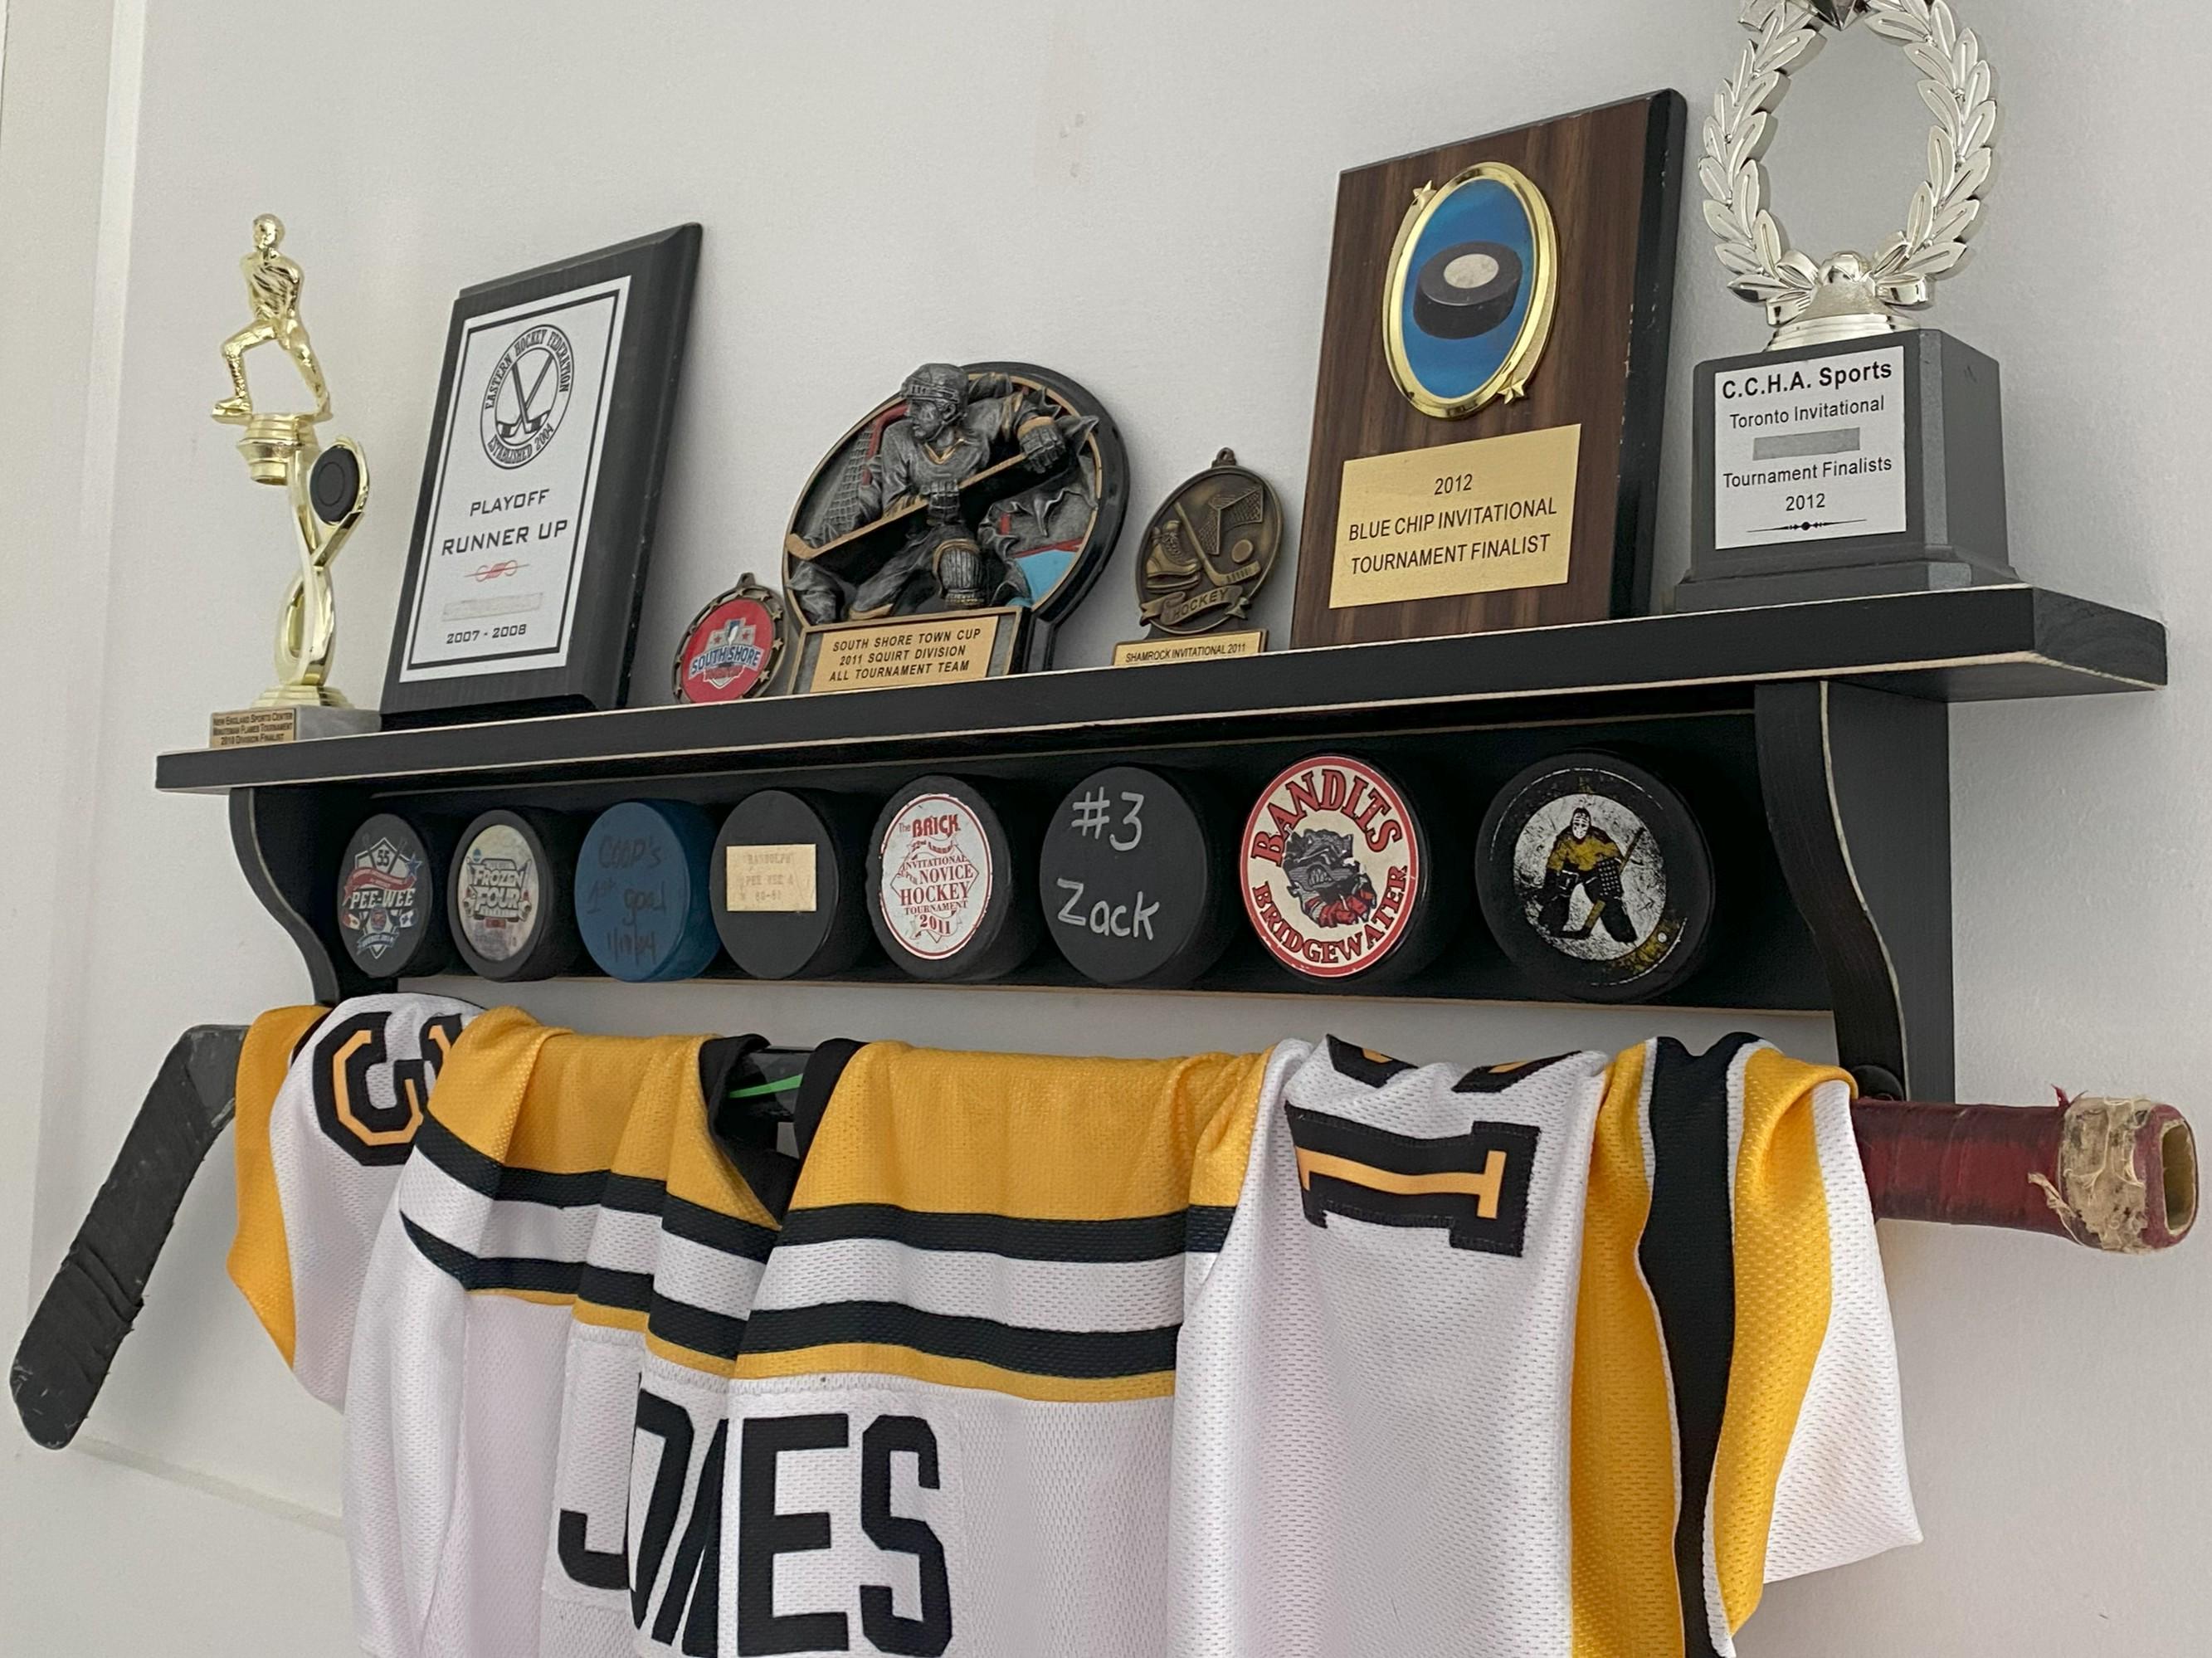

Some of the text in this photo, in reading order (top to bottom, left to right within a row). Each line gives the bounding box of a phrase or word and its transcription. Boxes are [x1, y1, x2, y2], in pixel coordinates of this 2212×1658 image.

[485, 329, 572, 410] EASTERN HOCKEY FEDERATION
[1722, 361, 1893, 399] C.C.H.A. Sports
[1730, 395, 1884, 429] Toronto Invitational
[487, 423, 553, 464] ESTABLISHED 2004
[1434, 474, 1473, 495] 2012
[1723, 457, 1893, 488] Tournament Finalists
[470, 489, 550, 516] PLAYOFF
[1786, 493, 1826, 512] 2012
[1349, 497, 1557, 541] BLUE CHIP INVITATIONAL
[441, 519, 568, 556] RUNNER UP
[1352, 534, 1551, 575] TOURNAMENT FINALIST
[1172, 588, 1230, 619] HOCKEY
[446, 630, 480, 644] 2007
[492, 624, 527, 639] 2008
[832, 628, 981, 652] SOUTH SHORE TOWN CUP
[690, 646, 726, 675] SOUTH
[728, 646, 761, 666] SHORE
[840, 645, 966, 666] 2011 SQUIRT DIVISION
[1125, 643, 1245, 663] SHAMROCK INVITATIONAL 2011
[829, 660, 969, 682] ALL TOURNAMENT TEAM
[912, 814, 960, 838] BRICK
[1071, 787, 1144, 851] #3
[1250, 768, 1403, 867] BANDITS
[376, 849, 390, 867] 55
[902, 855, 969, 871] INVITATIONAL
[470, 864, 526, 888] FROZEN
[919, 863, 974, 885] NOVICE
[348, 887, 416, 910] PEE-WEE
[471, 885, 522, 912] FOUR
[900, 881, 970, 905] HOCKEY
[904, 900, 968, 915] TOURNAMENT
[1056, 878, 1160, 940] Zack
[1252, 866, 1408, 964] BRIDGEWATER
[919, 914, 951, 934] 2011
